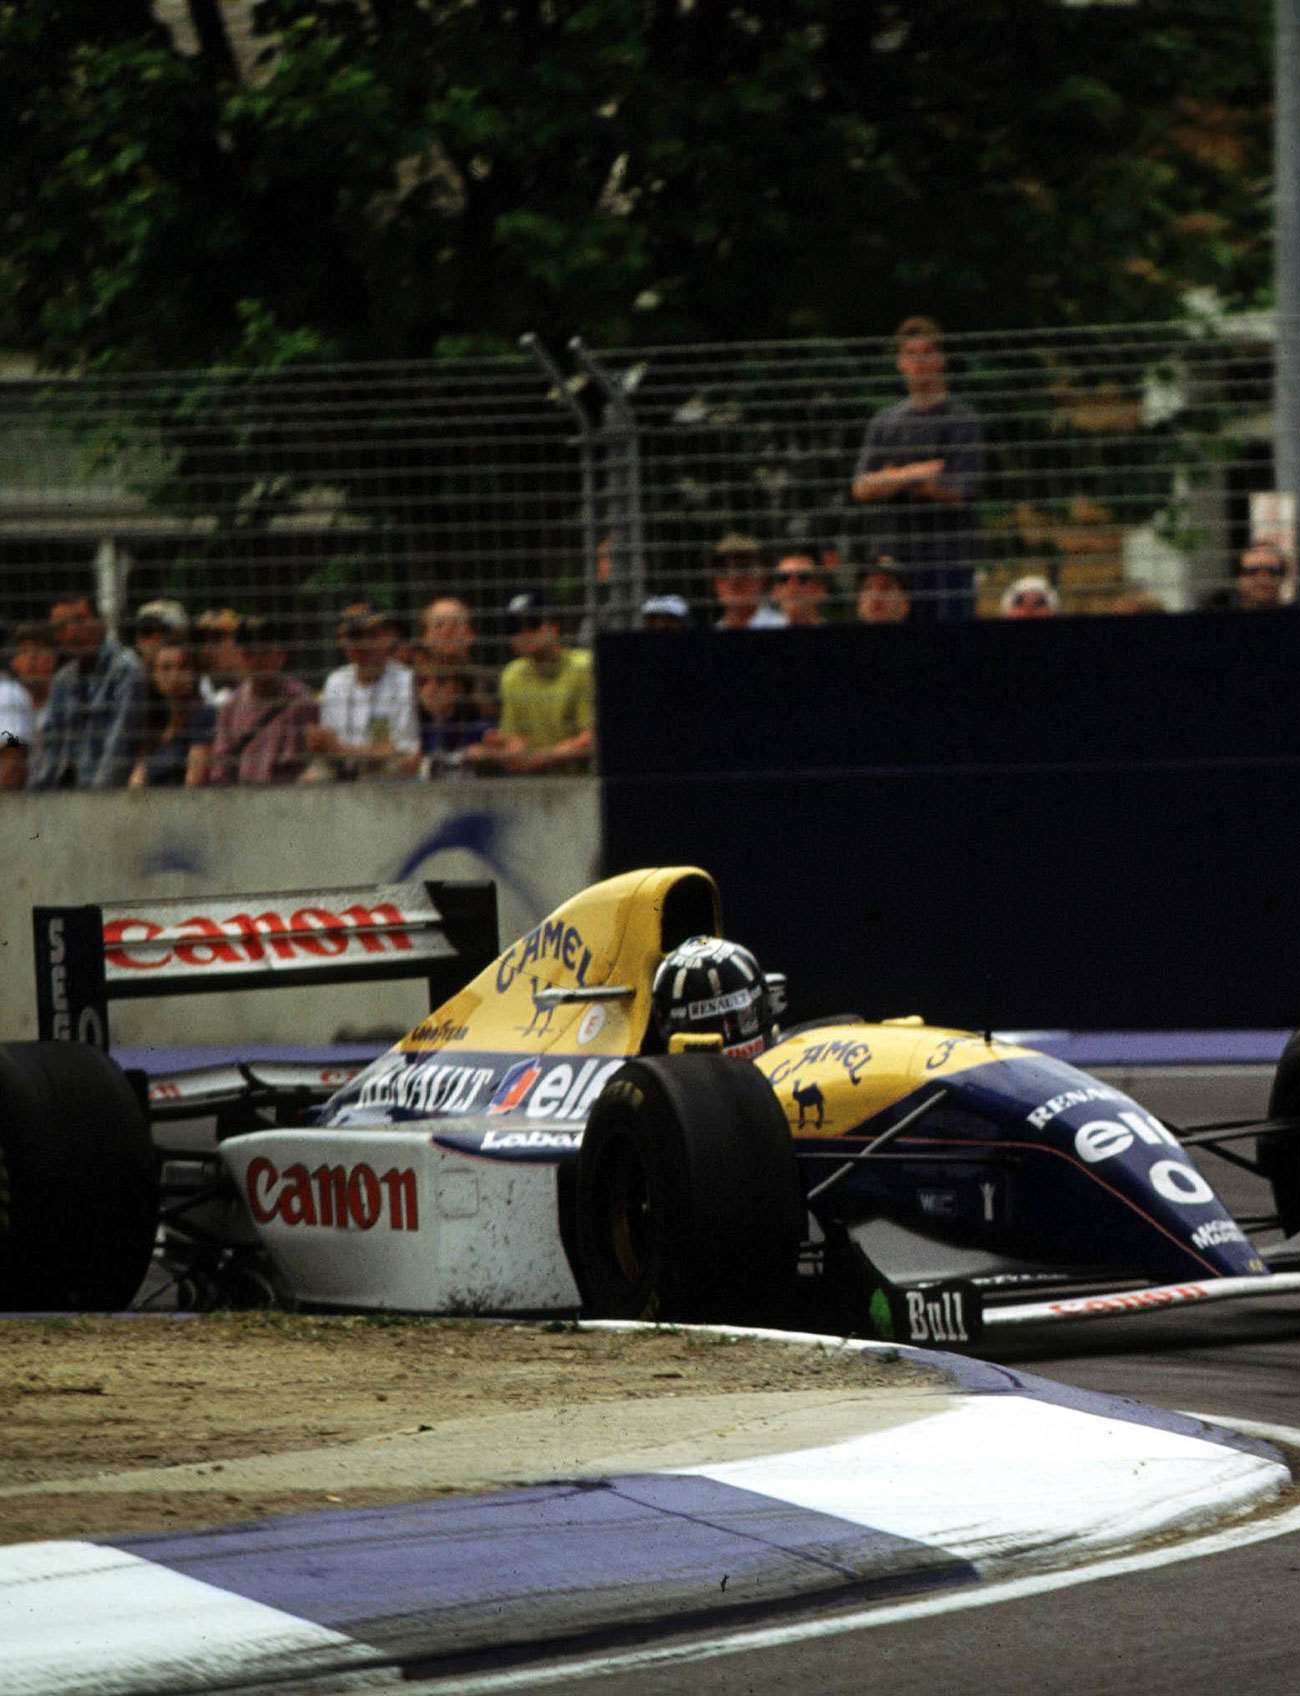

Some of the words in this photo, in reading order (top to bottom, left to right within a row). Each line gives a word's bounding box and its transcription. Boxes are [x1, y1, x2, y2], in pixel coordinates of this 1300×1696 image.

[103, 904, 413, 970] Canon
[496, 918, 593, 994] CAMEL
[769, 1039, 873, 1086] CAMEL
[246, 1156, 420, 1232] Canon
[905, 1291, 968, 1342] Bull
